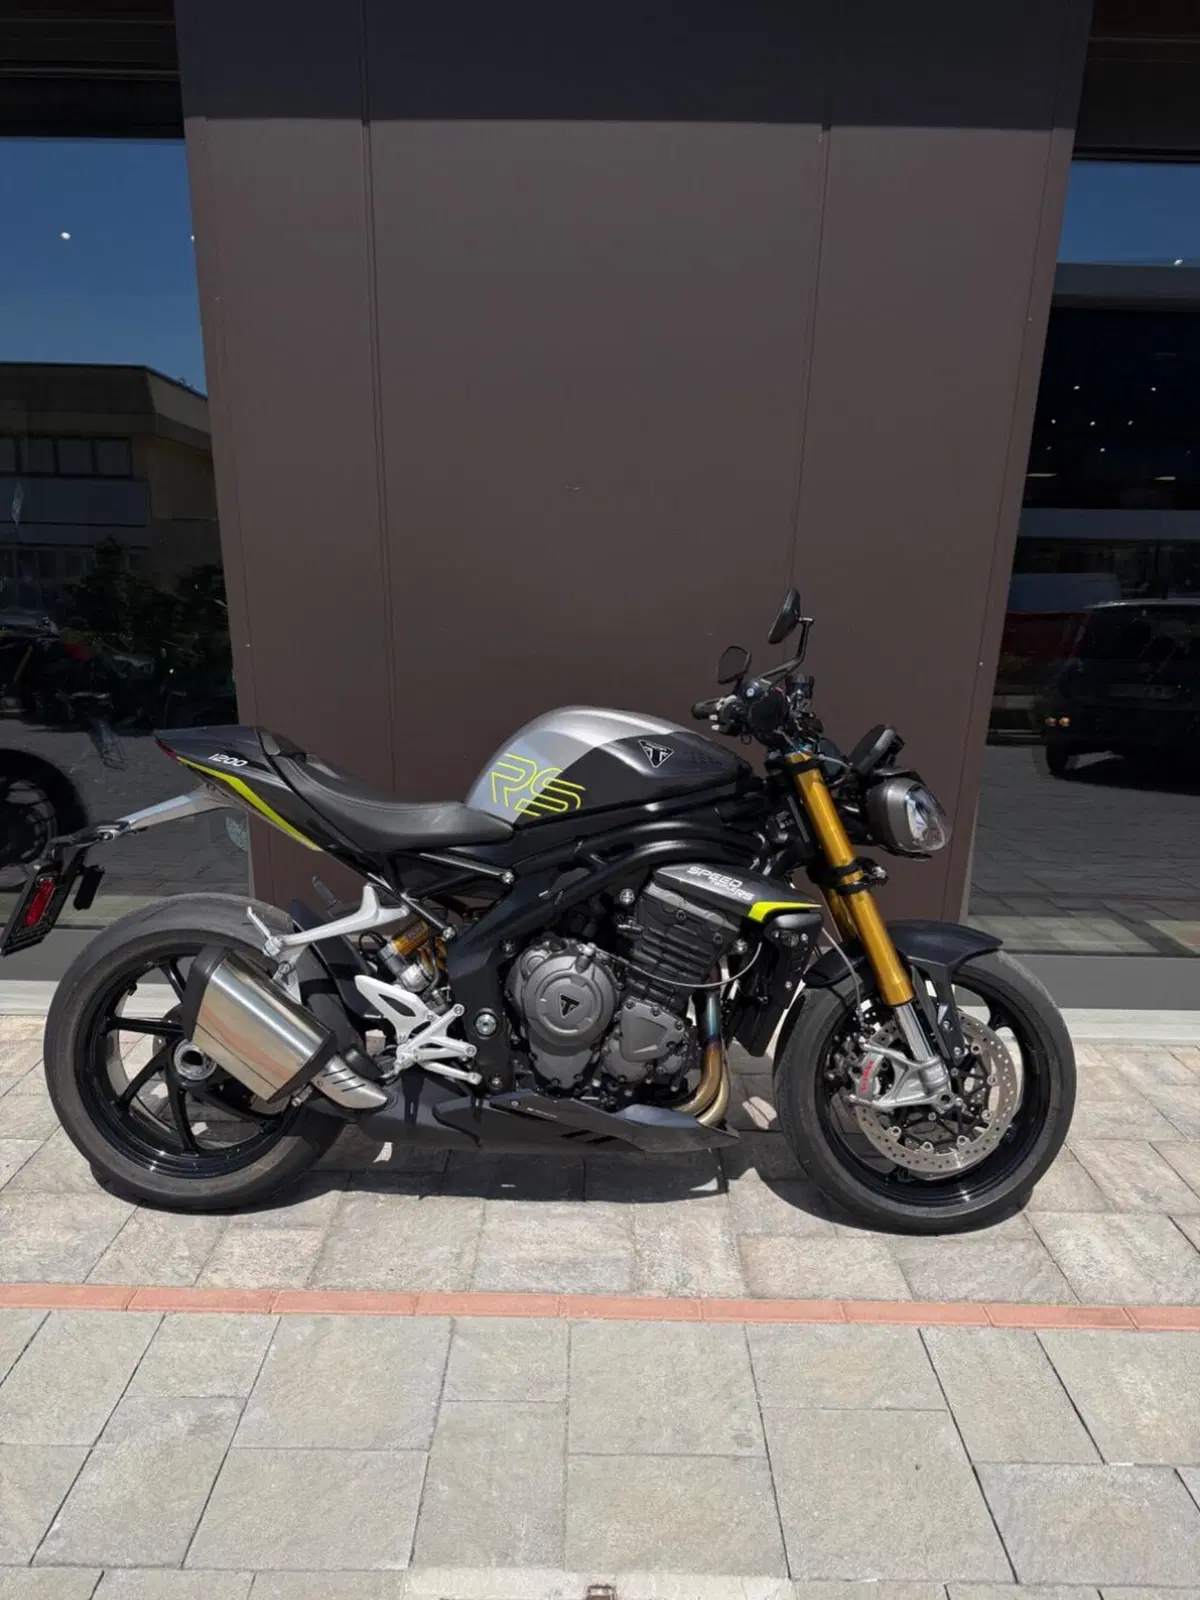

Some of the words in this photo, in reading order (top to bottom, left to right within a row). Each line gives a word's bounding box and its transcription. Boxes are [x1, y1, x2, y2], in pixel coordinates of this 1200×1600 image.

[207, 753, 249, 767] 1200
[491, 753, 586, 817] RS
[687, 866, 743, 888] SPEED
